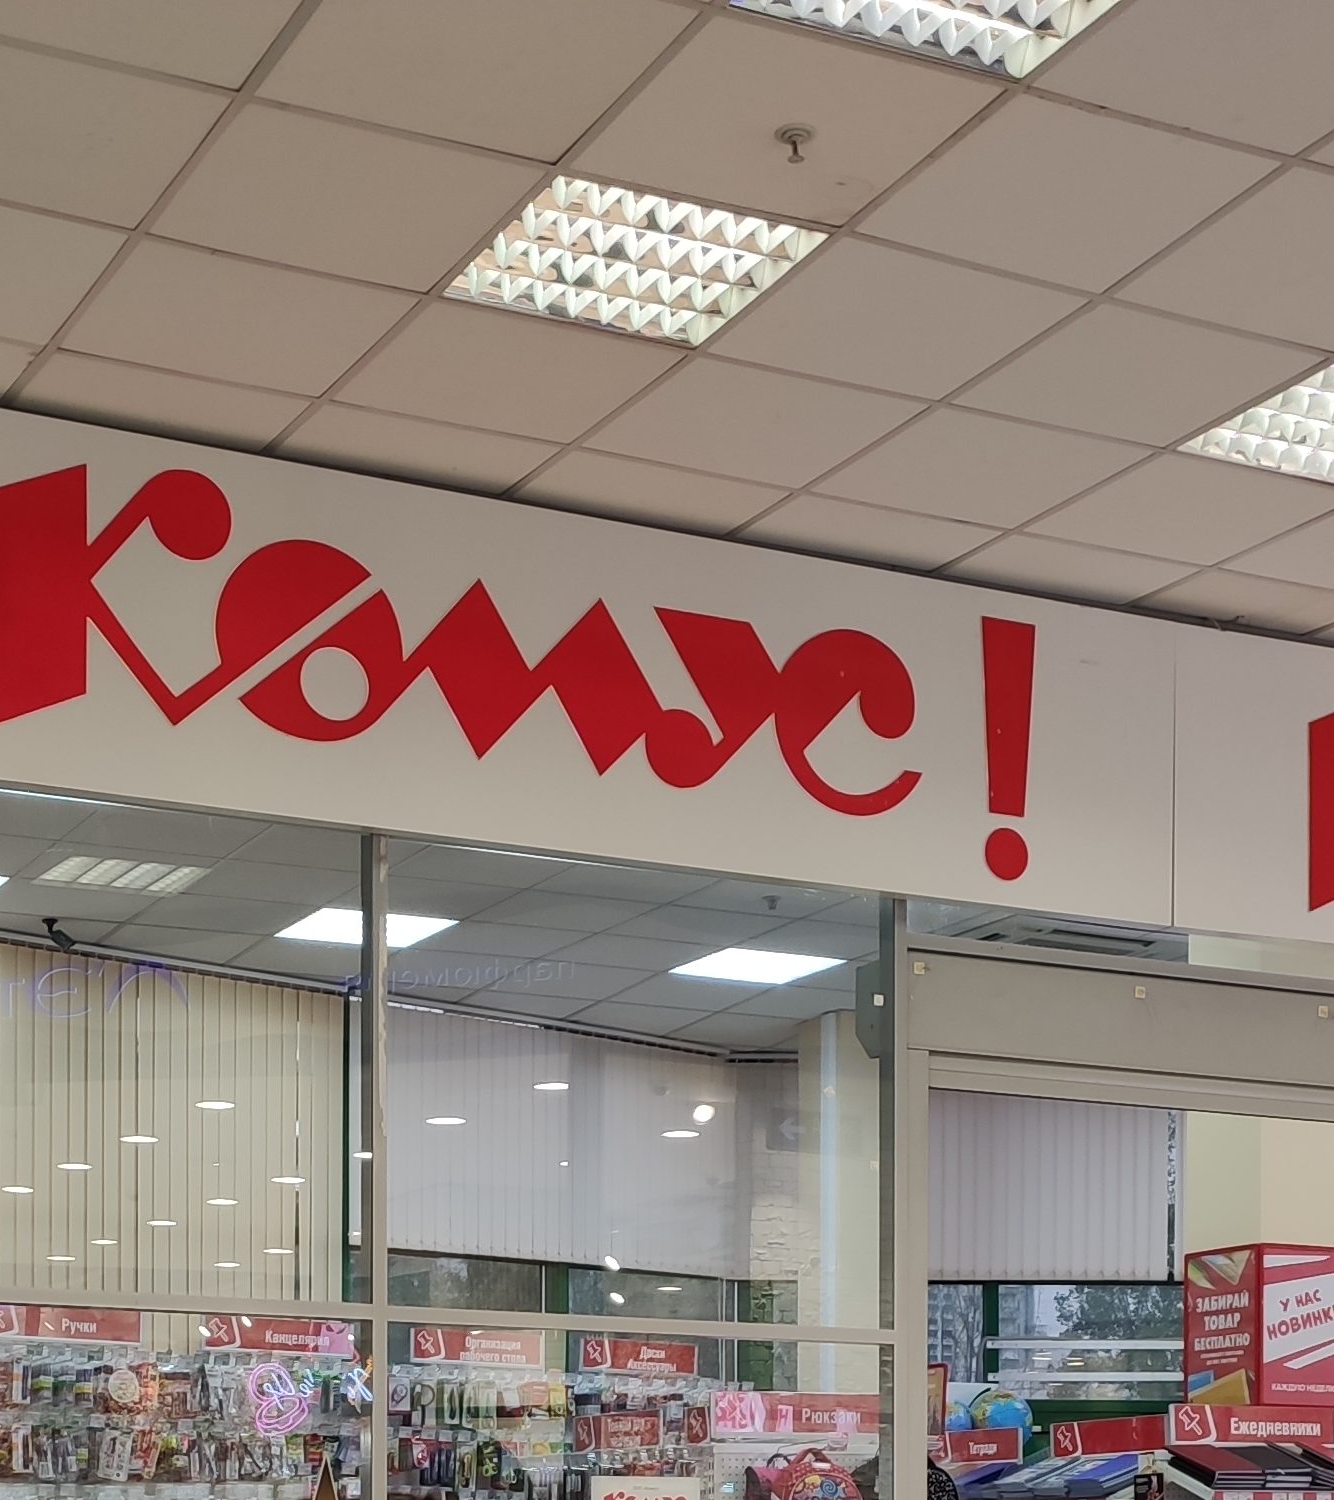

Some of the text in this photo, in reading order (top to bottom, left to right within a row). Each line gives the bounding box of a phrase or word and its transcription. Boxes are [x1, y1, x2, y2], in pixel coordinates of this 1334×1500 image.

[1195, 1290, 1250, 1313] ЗАБИРАЙ
[1279, 1288, 1322, 1313] У НАС
[61, 1318, 97, 1334] Ручки
[1204, 1313, 1241, 1331] ТОВАР
[1194, 1333, 1251, 1351] БЕСПЛАТНО
[801, 1407, 862, 1425] Рюкзаки
[1229, 1417, 1321, 1437] Ежедневники
